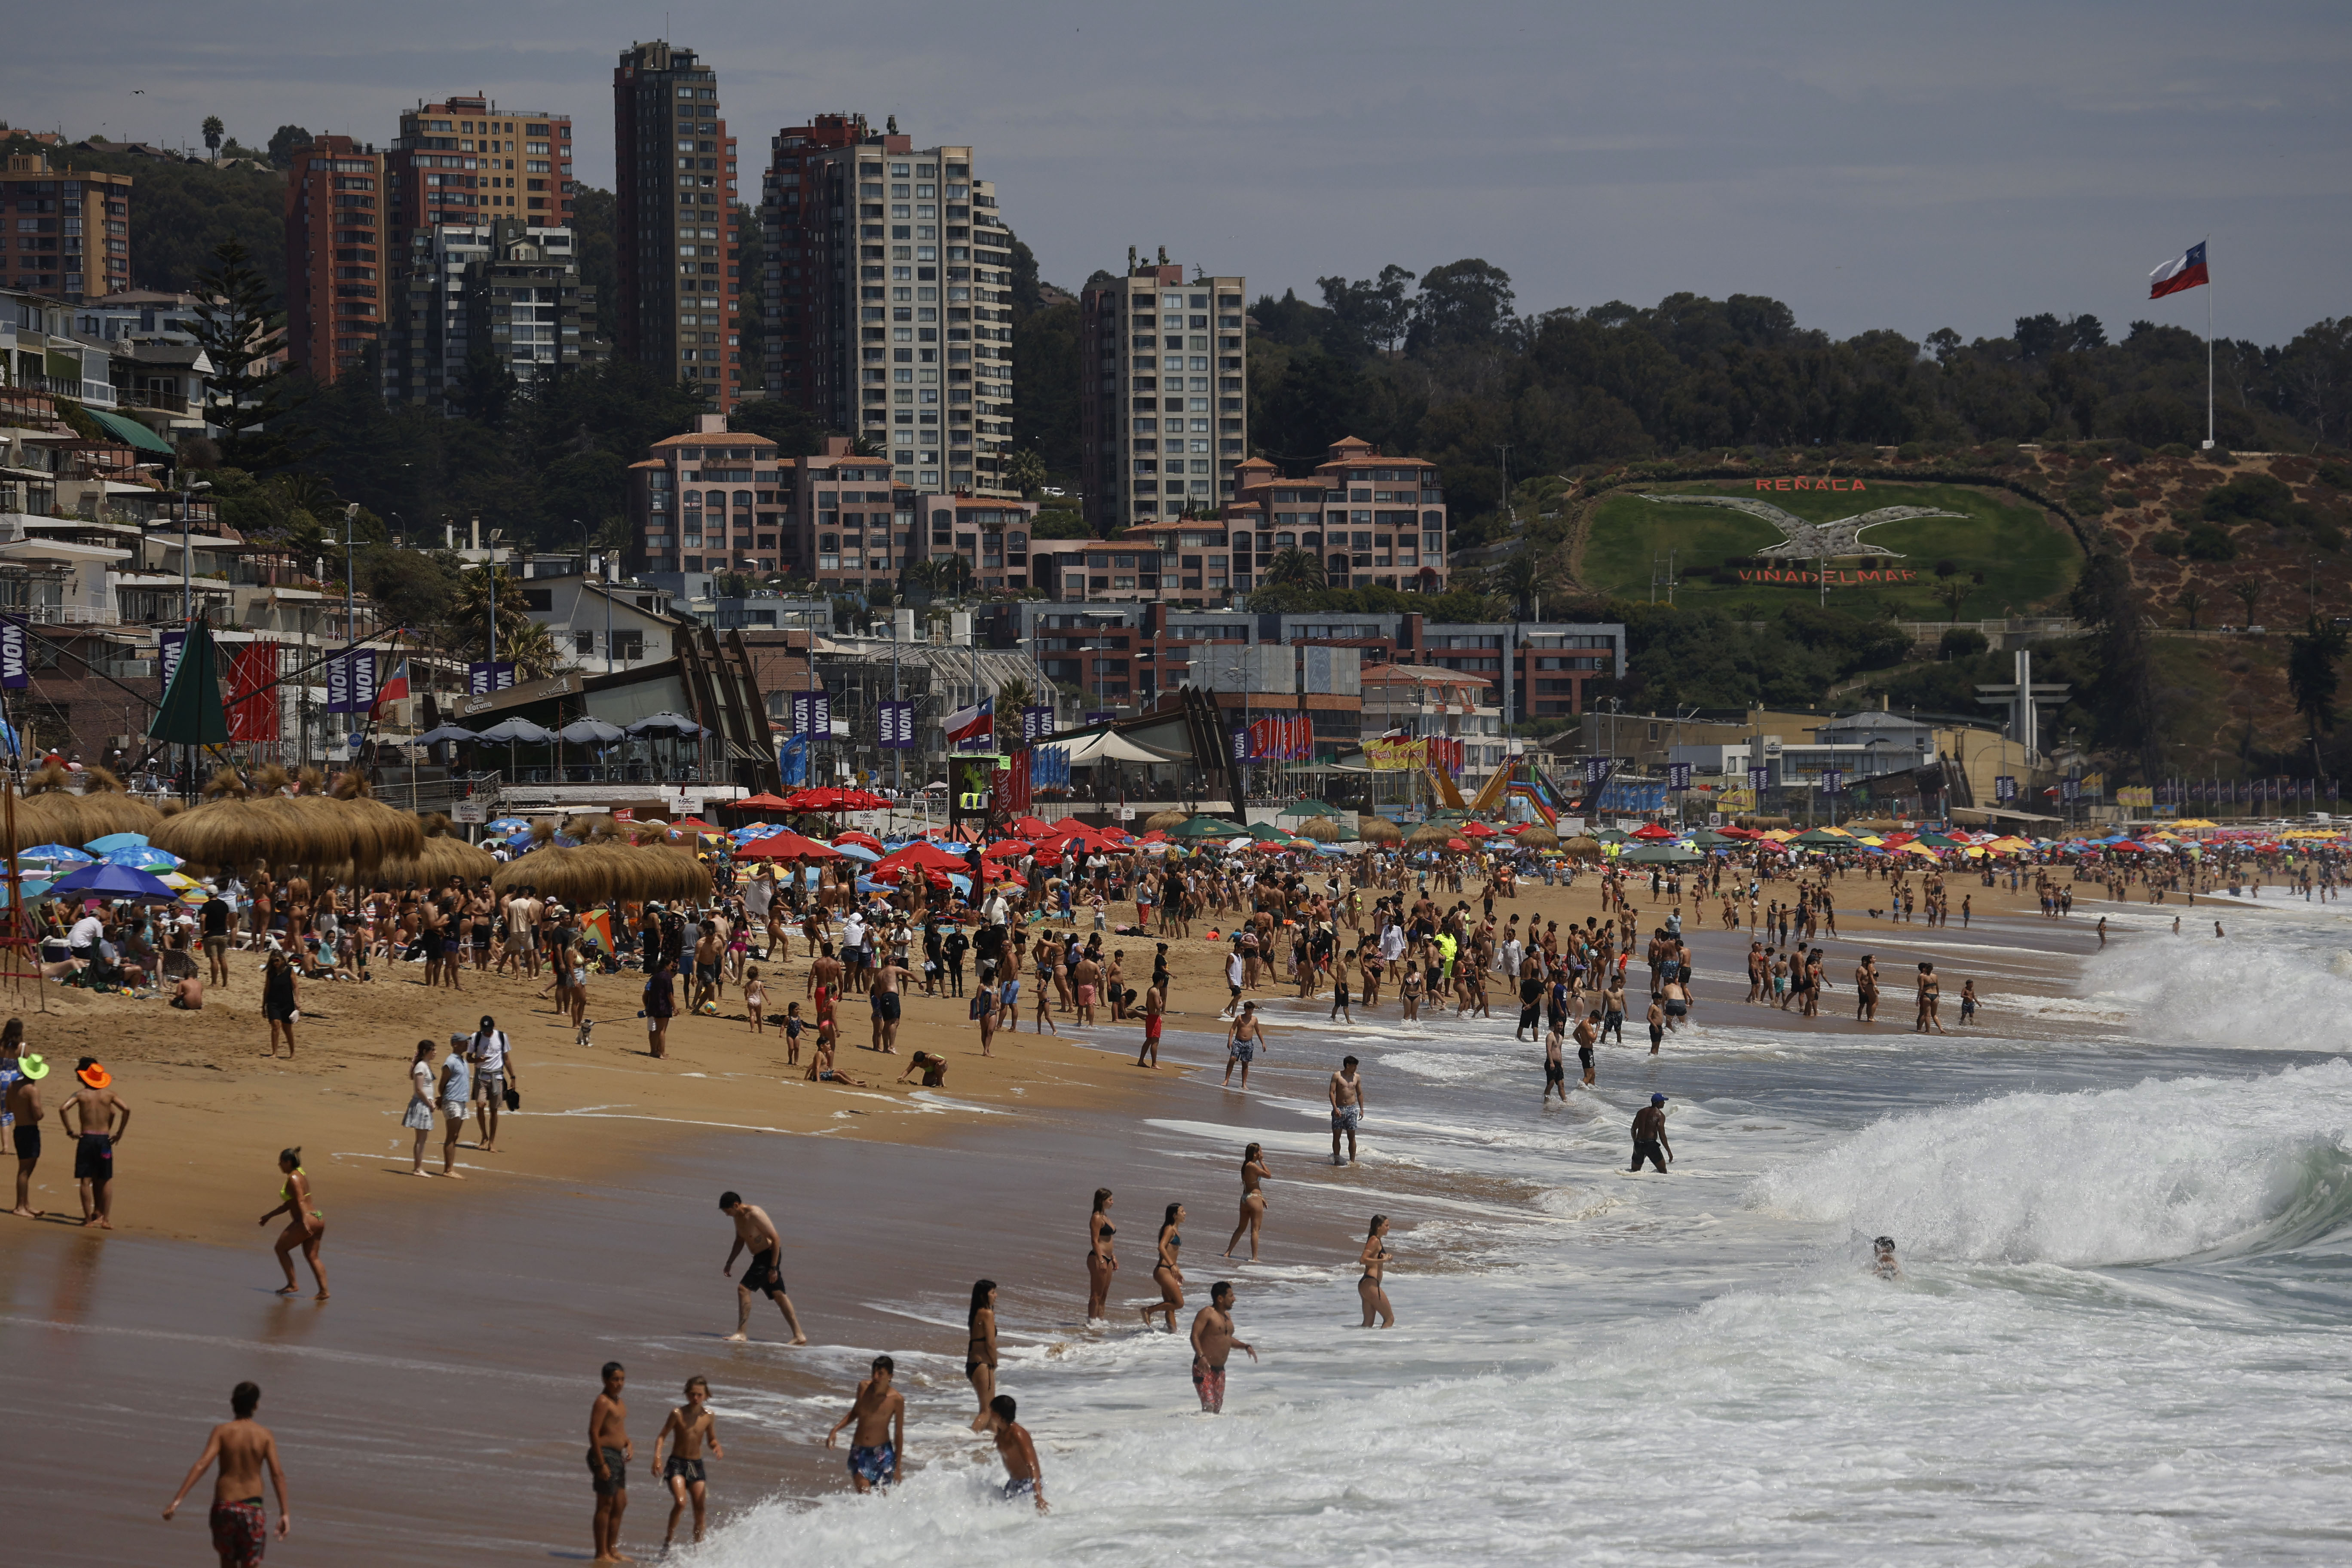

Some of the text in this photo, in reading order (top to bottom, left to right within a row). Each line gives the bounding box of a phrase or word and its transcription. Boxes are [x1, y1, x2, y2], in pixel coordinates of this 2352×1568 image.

[1756, 476, 1866, 490] REÑACA
[3, 625, 22, 678] WOM
[330, 658, 347, 704] WOM
[356, 657, 373, 703] WOM
[465, 702, 492, 713] Corona
[815, 698, 828, 733] WOM
[881, 707, 892, 741] WOM
[899, 707, 911, 741] WOM
[1235, 733, 1244, 759] WOM
